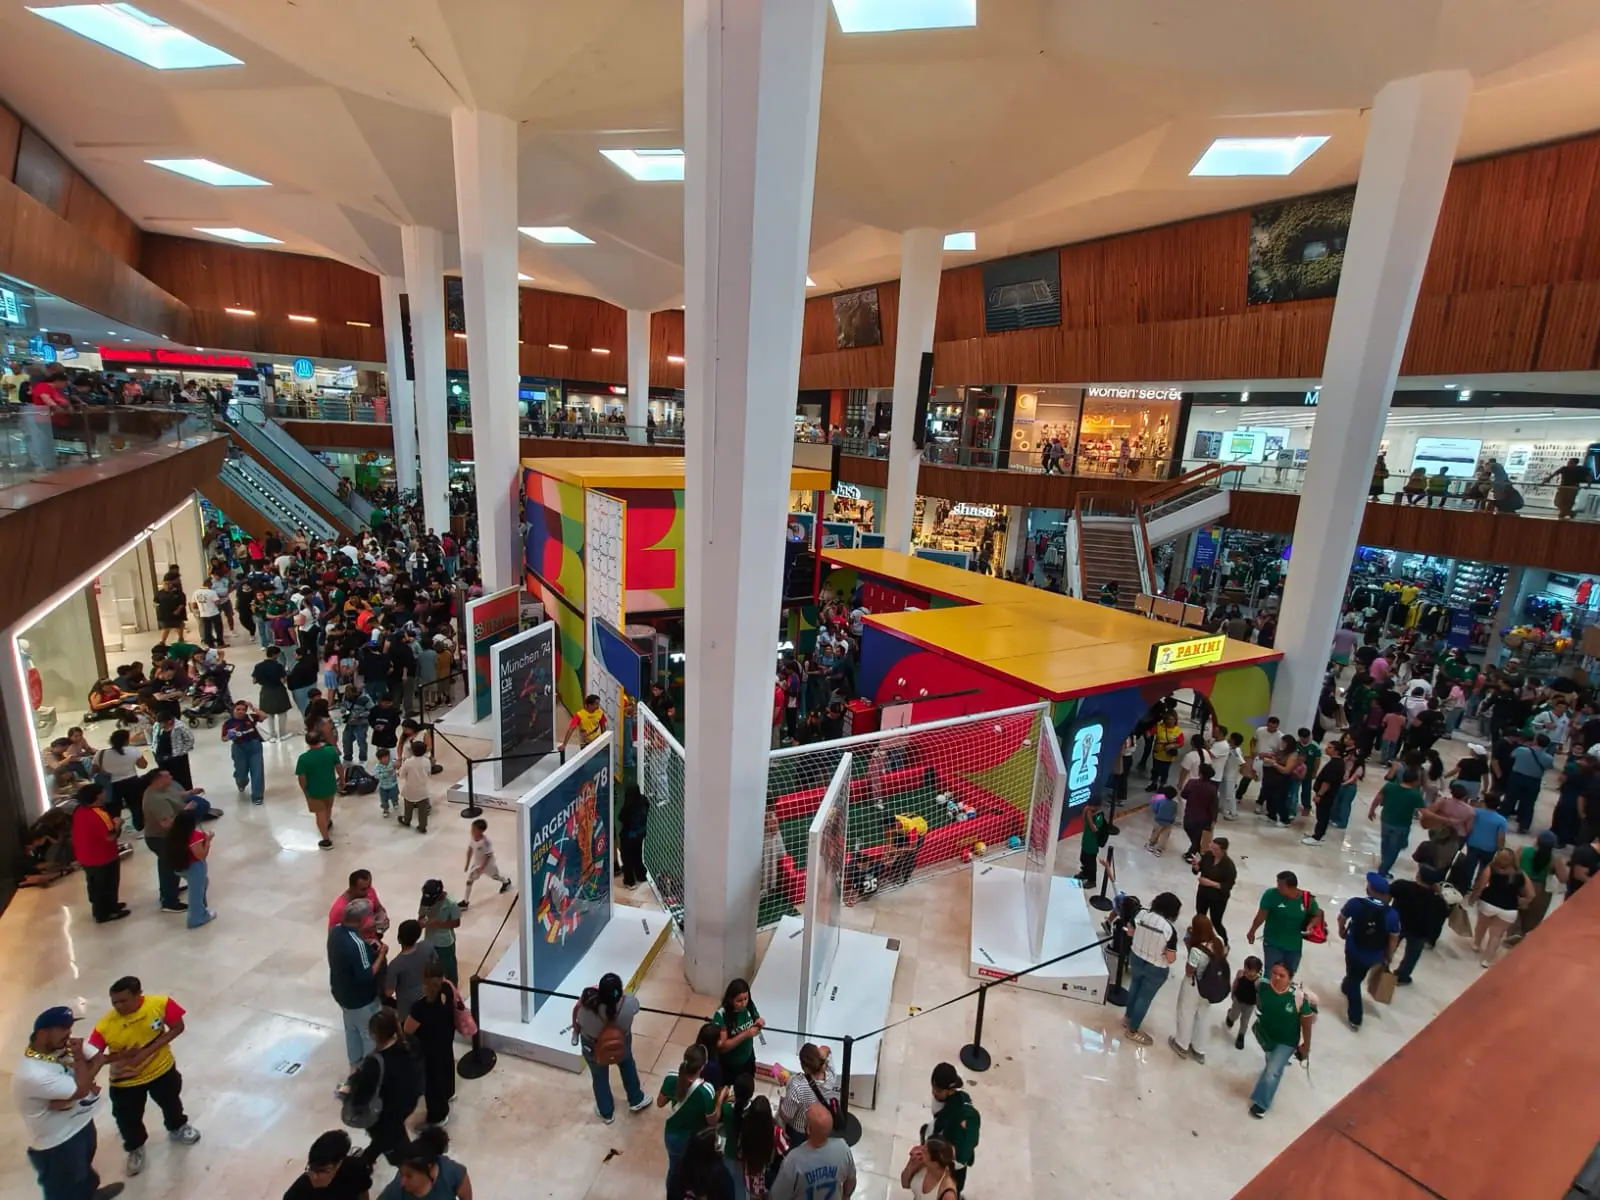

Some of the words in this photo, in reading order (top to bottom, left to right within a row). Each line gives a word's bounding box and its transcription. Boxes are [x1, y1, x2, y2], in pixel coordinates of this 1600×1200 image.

[541, 641, 551, 657] 74
[1177, 640, 1221, 658] PANINI
[533, 787, 595, 851] ARGENTINA
[593, 766, 608, 795] 78
[805, 1165, 838, 1184] OHTANI
